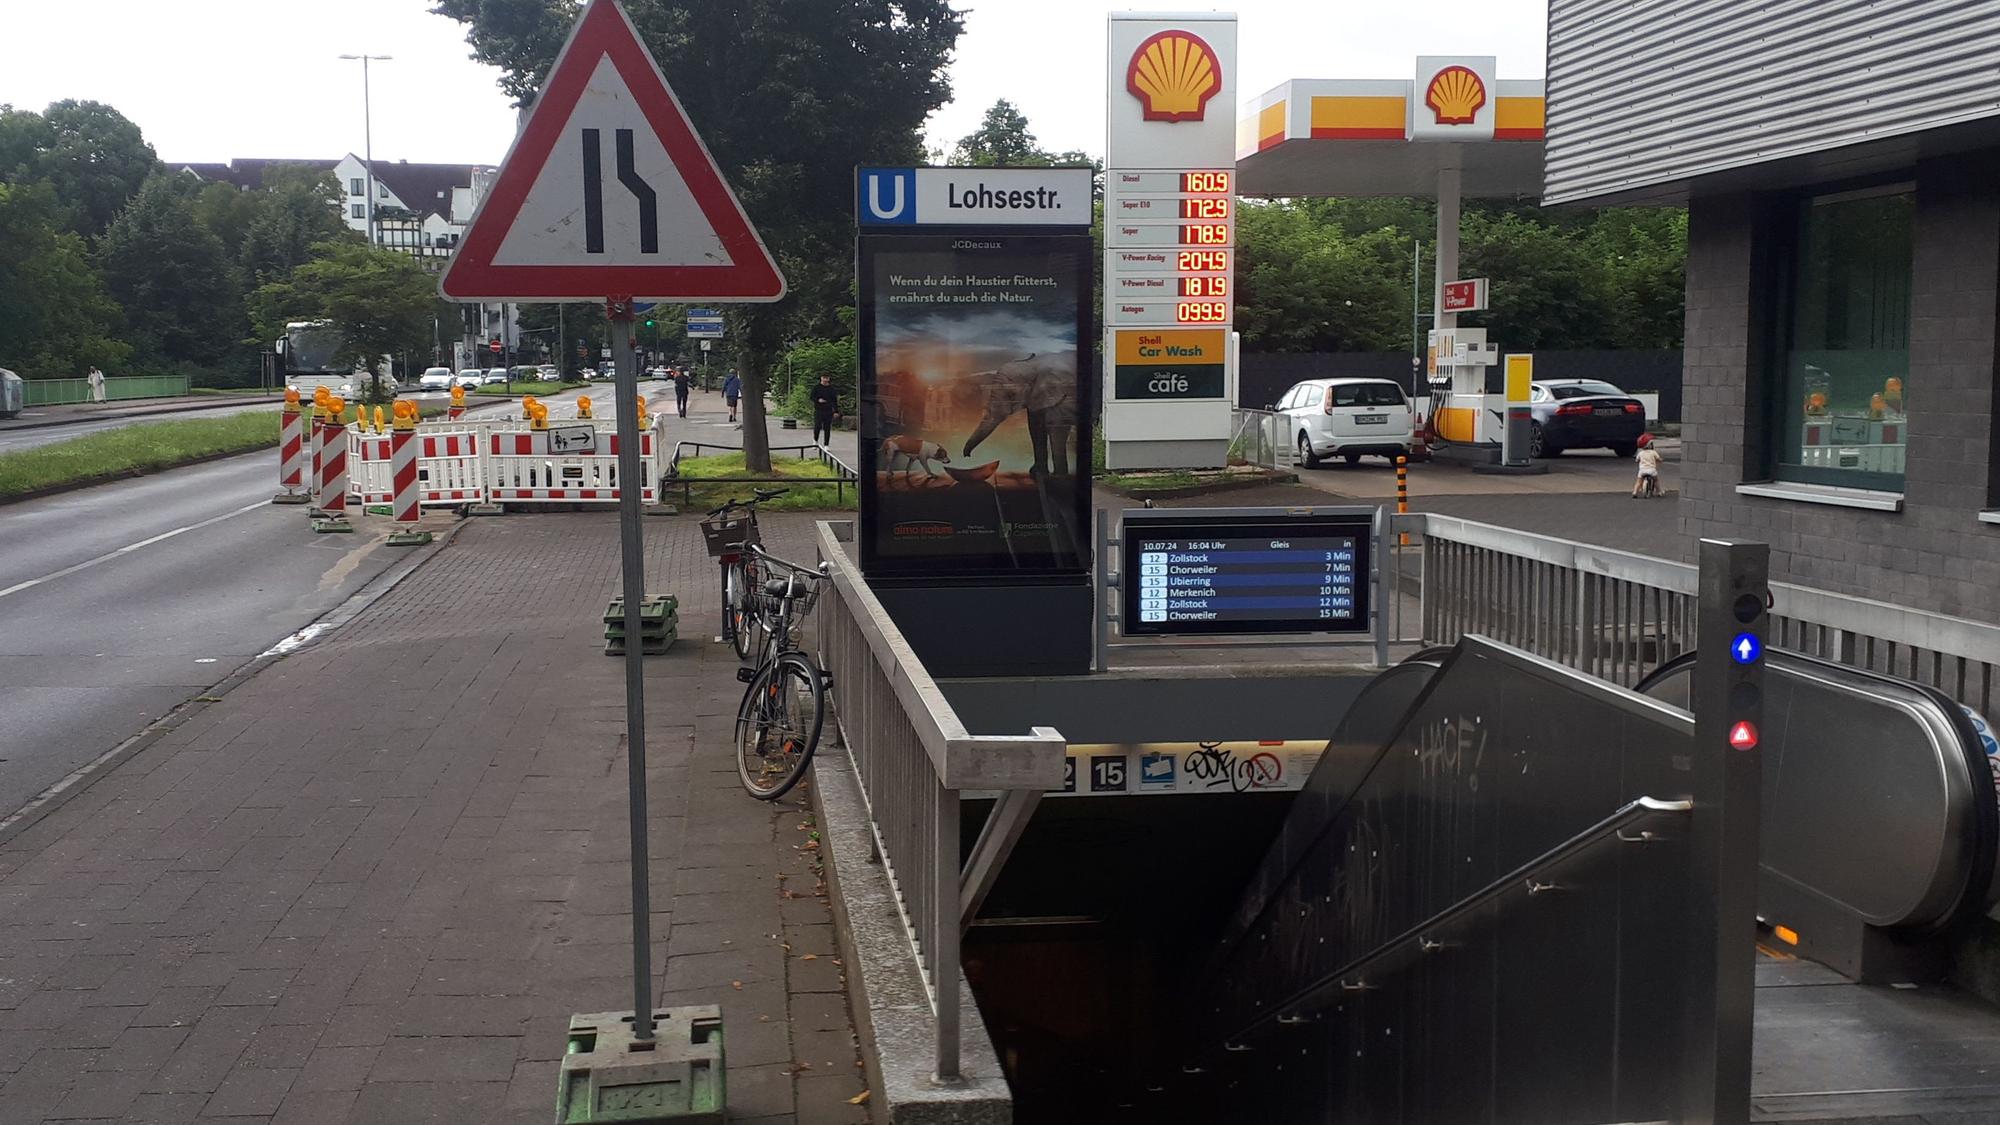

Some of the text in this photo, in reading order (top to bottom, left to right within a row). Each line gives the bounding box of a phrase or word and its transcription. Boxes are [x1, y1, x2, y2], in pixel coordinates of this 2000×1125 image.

[1186, 173, 1228, 192] 160.9
[868, 174, 1061, 219] U Lohsestr.
[1123, 201, 1138, 211] Super
[1186, 200, 1227, 218] 172.9
[1122, 225, 1227, 244] Super 178.9
[952, 240, 1002, 249] JCDecaux
[1146, 254, 1166, 263] Racing
[1179, 252, 1226, 270] 204.9
[890, 275, 1057, 289] Wenn du dein Haustier fütterst,
[890, 292, 1033, 303] ernährst du auch die Natur.
[1122, 303, 1225, 321] Autogas 099.9
[1139, 336, 1161, 344] Shell
[1139, 345, 1202, 357] Car Wash
[1148, 374, 1188, 392] café
[1144, 540, 1351, 550] 10.07.24 16:04 Uhr Gleis in
[1149, 552, 1351, 563] 12 Zollstock 3 Min
[1149, 566, 1160, 574] 15
[1170, 565, 1217, 574] Chorweiler
[1333, 563, 1351, 572] Min
[1149, 575, 1350, 587] 15 Ubierring 9 Min
[1149, 586, 1350, 597] 12 Merkenich 10 Min
[1149, 597, 1350, 608] 12 Zollstock 12 Min
[1149, 608, 1350, 620] 15 Chorweiler 15 Min
[1095, 762, 1123, 785] 15
